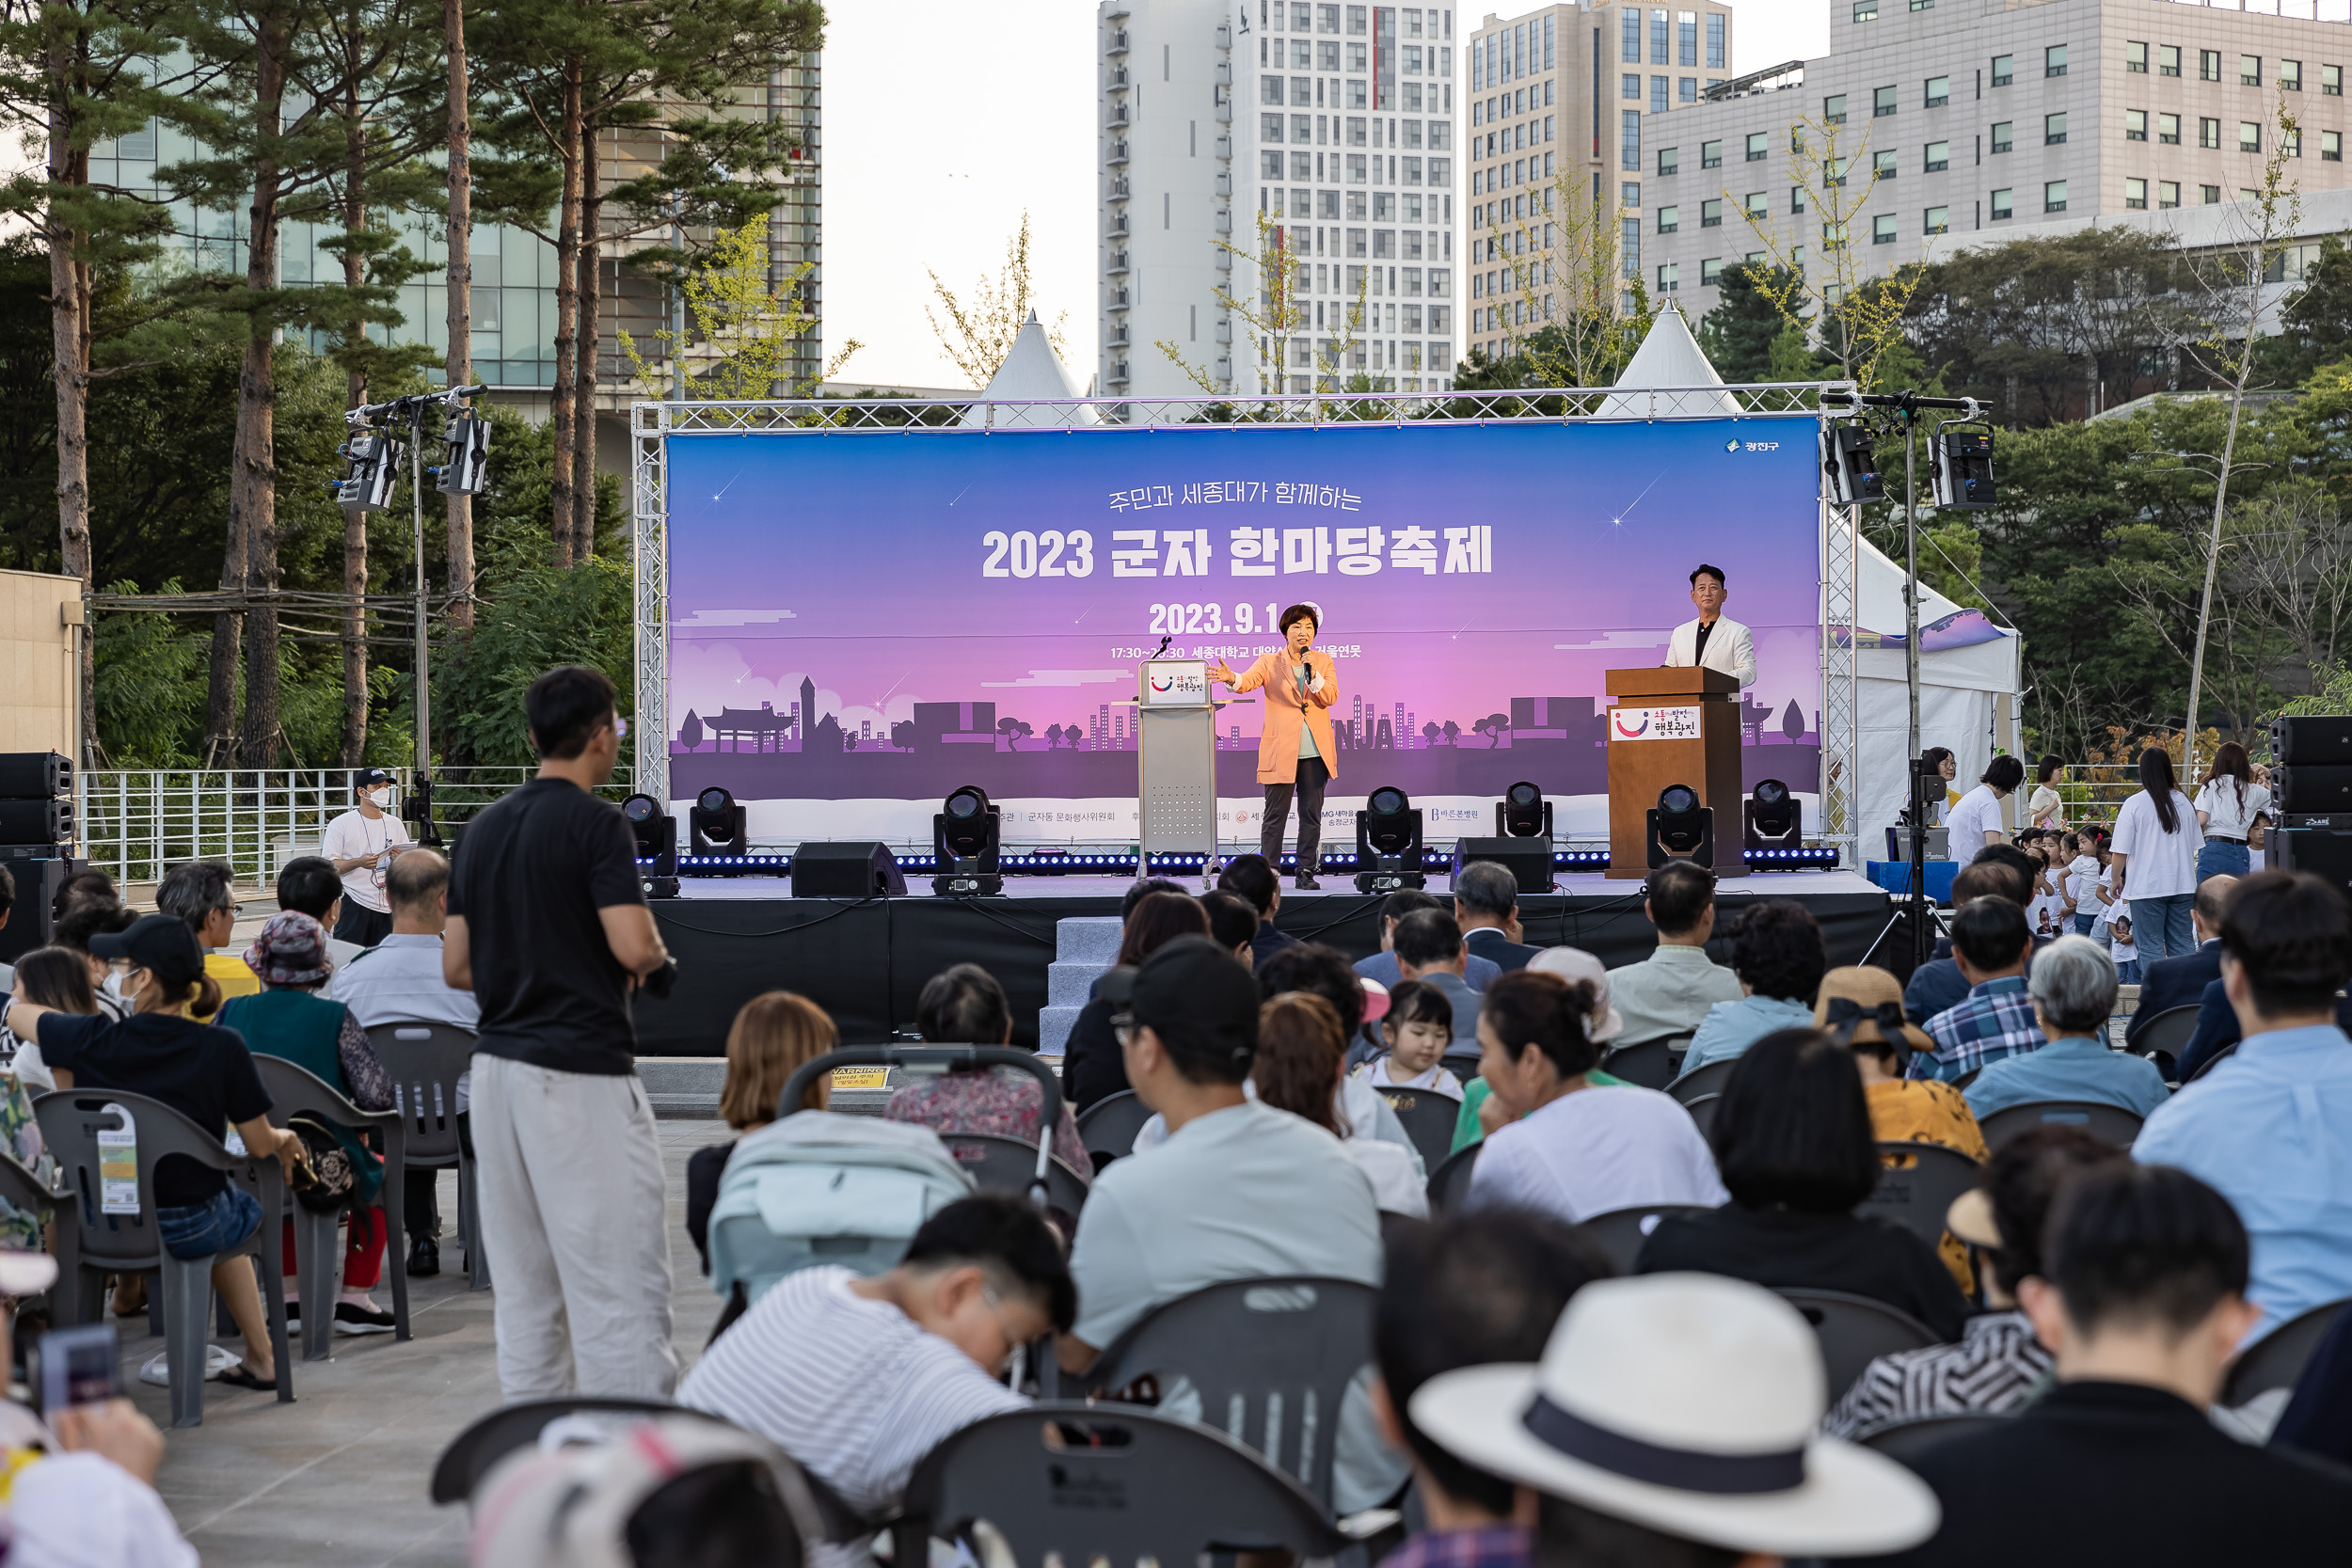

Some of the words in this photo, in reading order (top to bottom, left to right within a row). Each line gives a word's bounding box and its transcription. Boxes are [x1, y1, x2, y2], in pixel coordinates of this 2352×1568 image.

[1745, 442, 1779, 451] 광진구
[1108, 484, 1174, 513] 주민과
[1181, 481, 1269, 505] 세종대가
[1275, 481, 1362, 512] 함께하는
[982, 530, 1094, 578] 2023
[1111, 528, 1213, 578] 군자
[1230, 525, 1492, 577] 한마당축제
[1191, 645, 1250, 658] 세종대학교
[1655, 721, 1694, 736] 행복광진
[1027, 812, 1054, 822] 군자동
[1056, 812, 1115, 823] 문화행사위원회
[1440, 809, 1478, 819] 바른본병원
